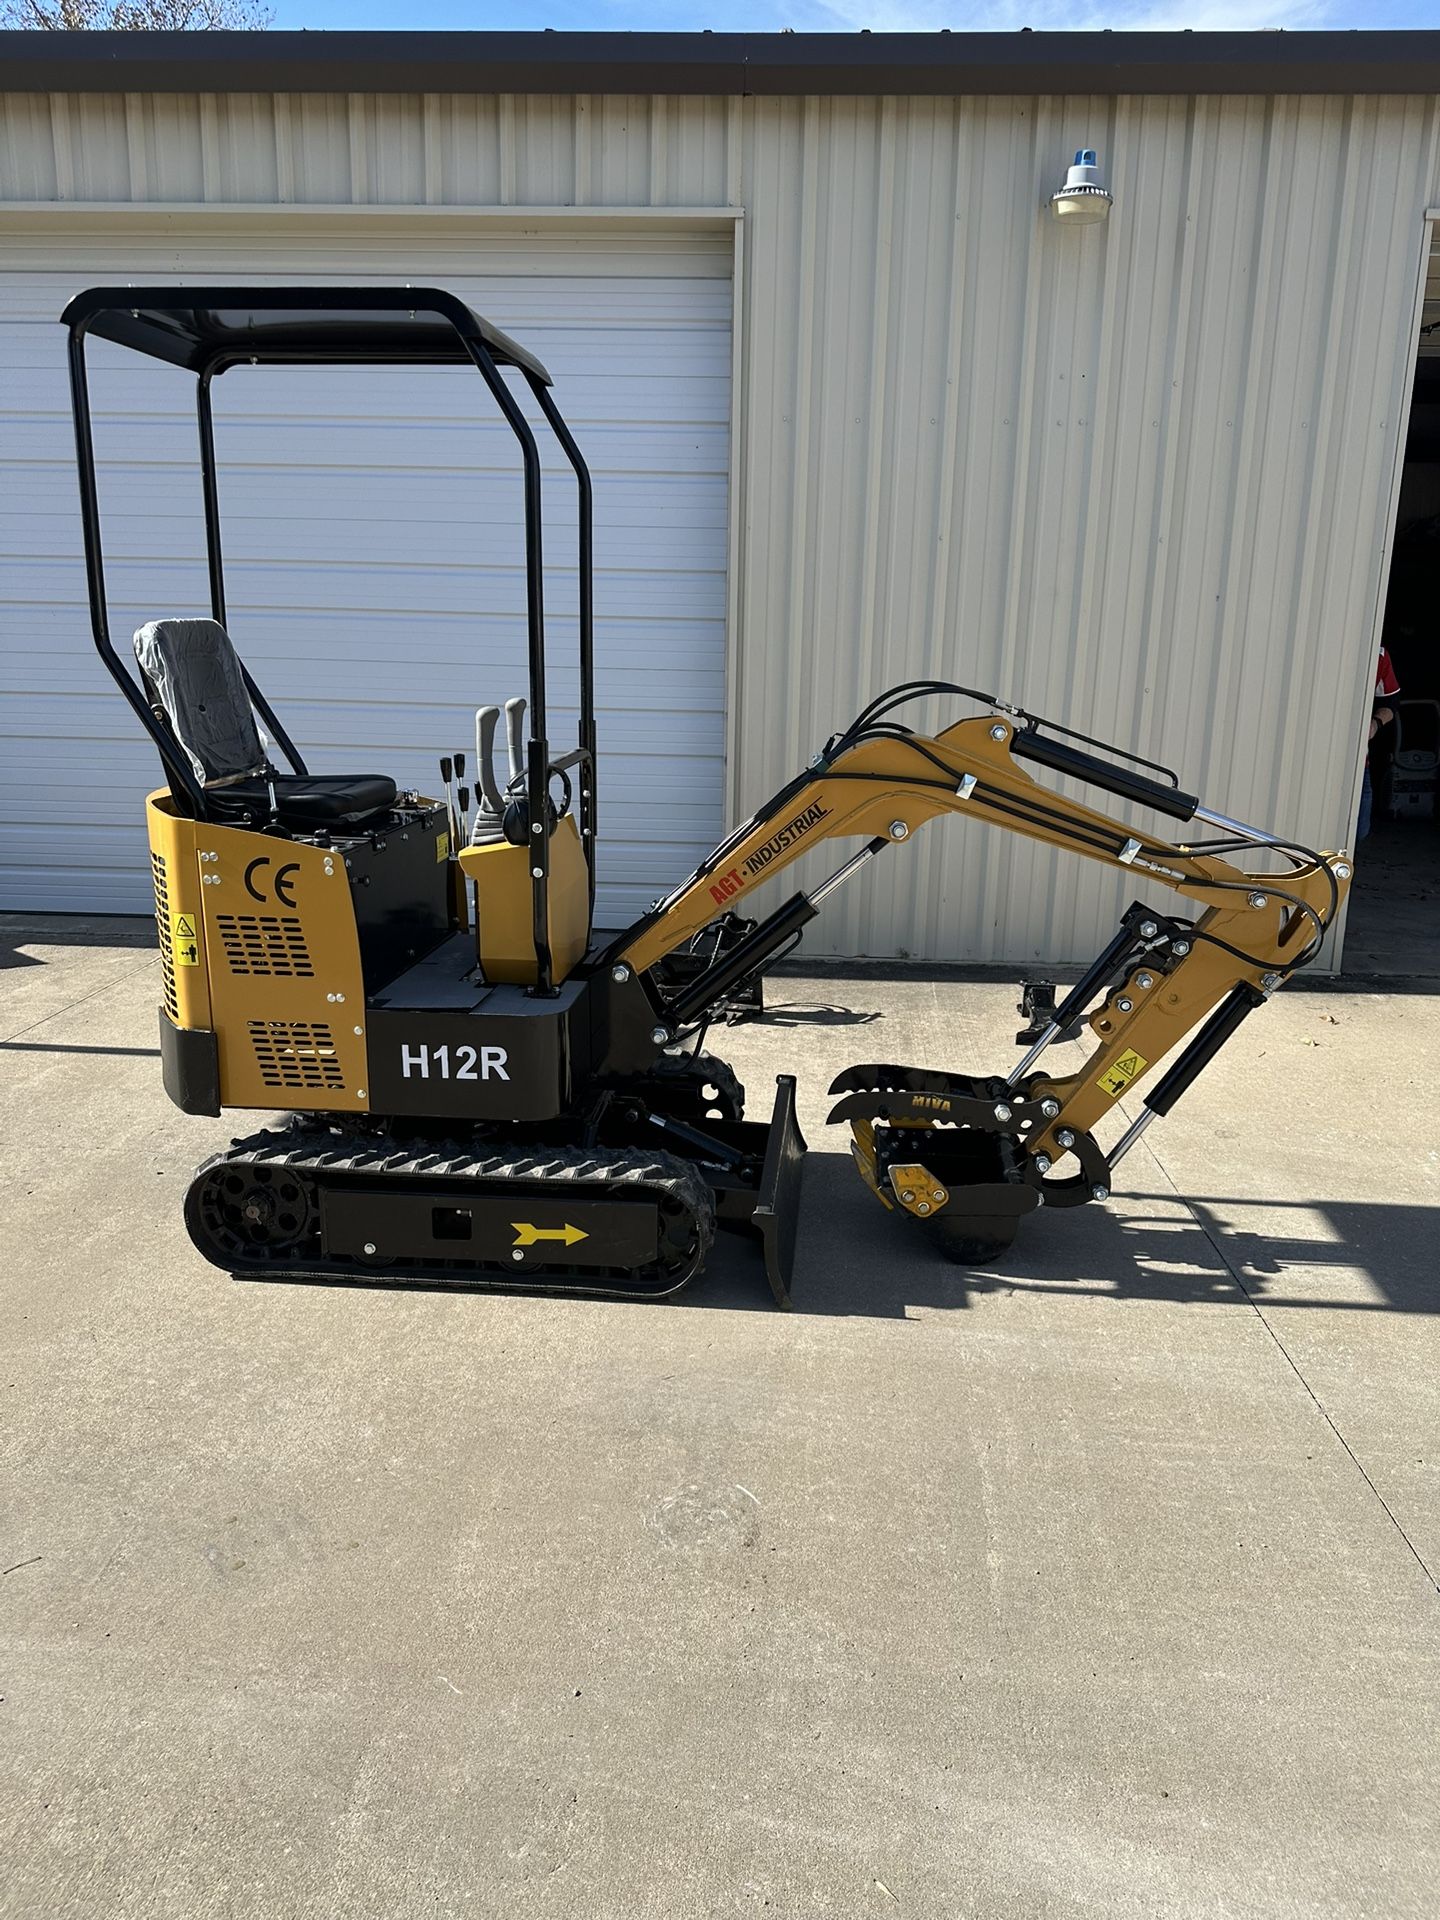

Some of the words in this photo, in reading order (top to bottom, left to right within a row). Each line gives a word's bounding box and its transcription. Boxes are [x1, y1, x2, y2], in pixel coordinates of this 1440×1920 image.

[709, 868, 745, 905] AGT
[745, 804, 828, 874] INDUSTRIAL
[244, 856, 301, 909] CE
[401, 1044, 511, 1081] H12R
